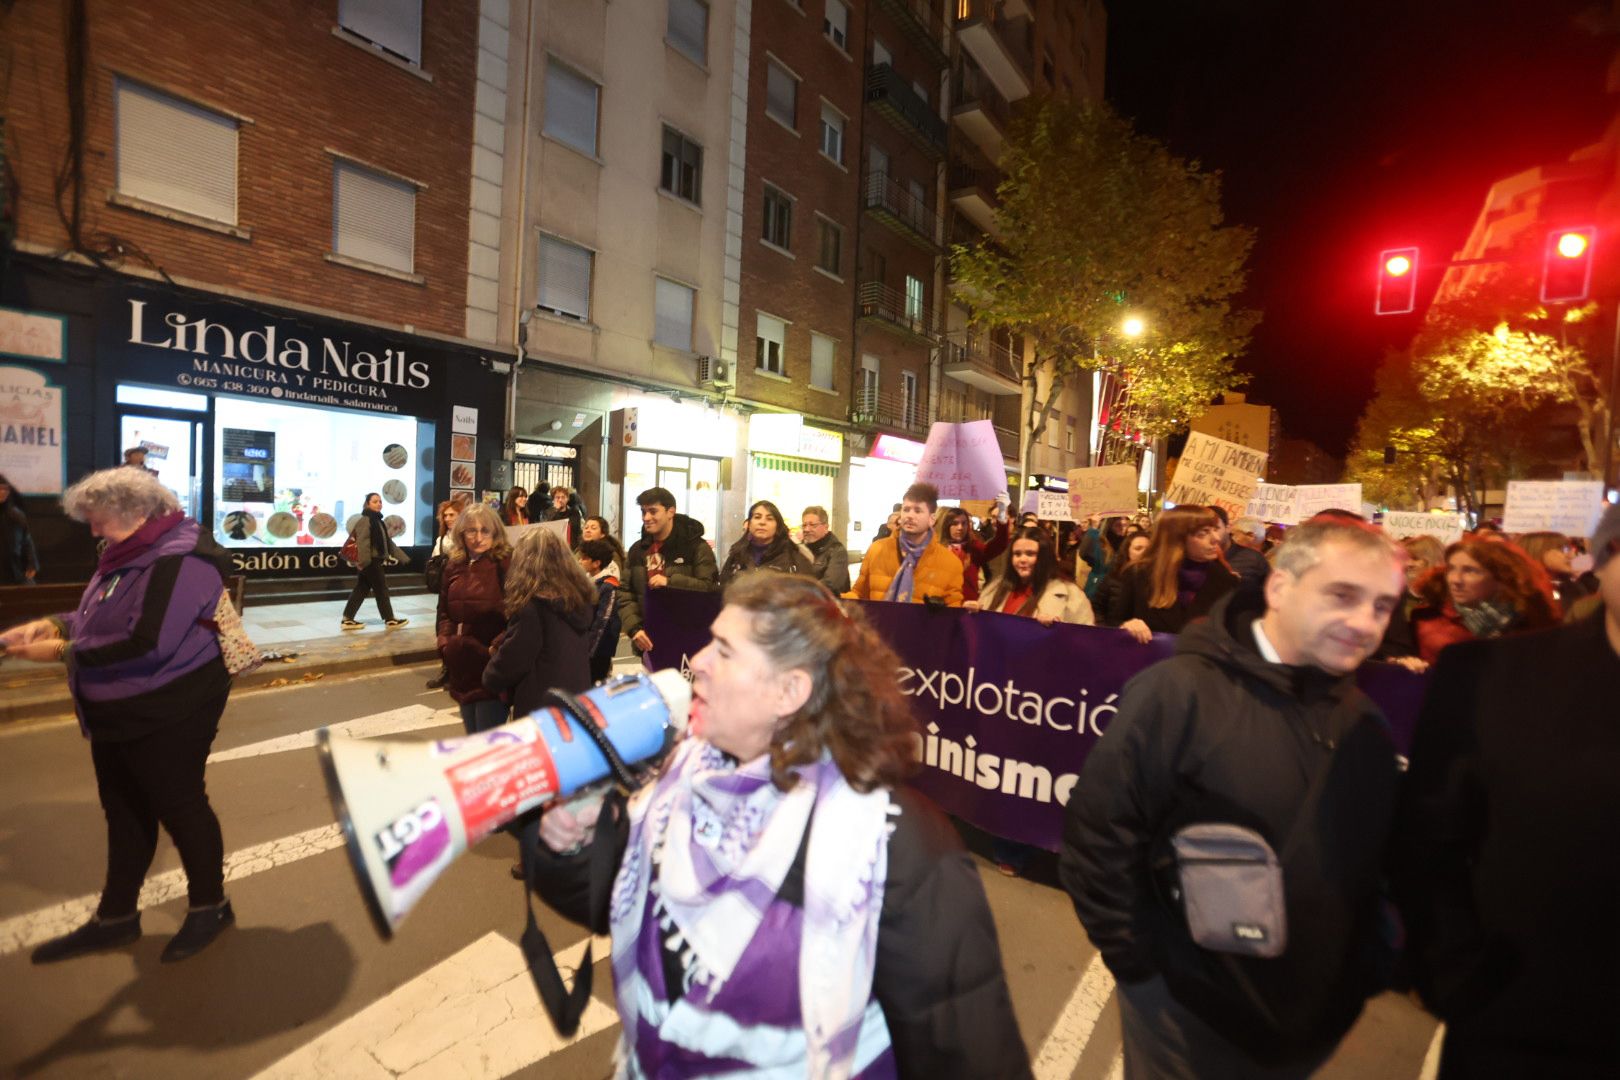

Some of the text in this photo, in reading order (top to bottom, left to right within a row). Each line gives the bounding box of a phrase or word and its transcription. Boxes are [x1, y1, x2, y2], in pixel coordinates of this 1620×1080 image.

[128, 299, 311, 372] Linda
[320, 337, 431, 389] Nails
[193, 358, 388, 399] MANICURA Y PEDICURA
[221, 380, 243, 391] 438
[247, 384, 269, 395] 360
[0, 425, 58, 446] ANEL
[1186, 437, 1198, 455] A
[1200, 440, 1220, 460] MI
[232, 551, 299, 571] Salón
[309, 551, 338, 569] de
[895, 665, 1121, 736] explotació
[913, 721, 1082, 807] inismo
